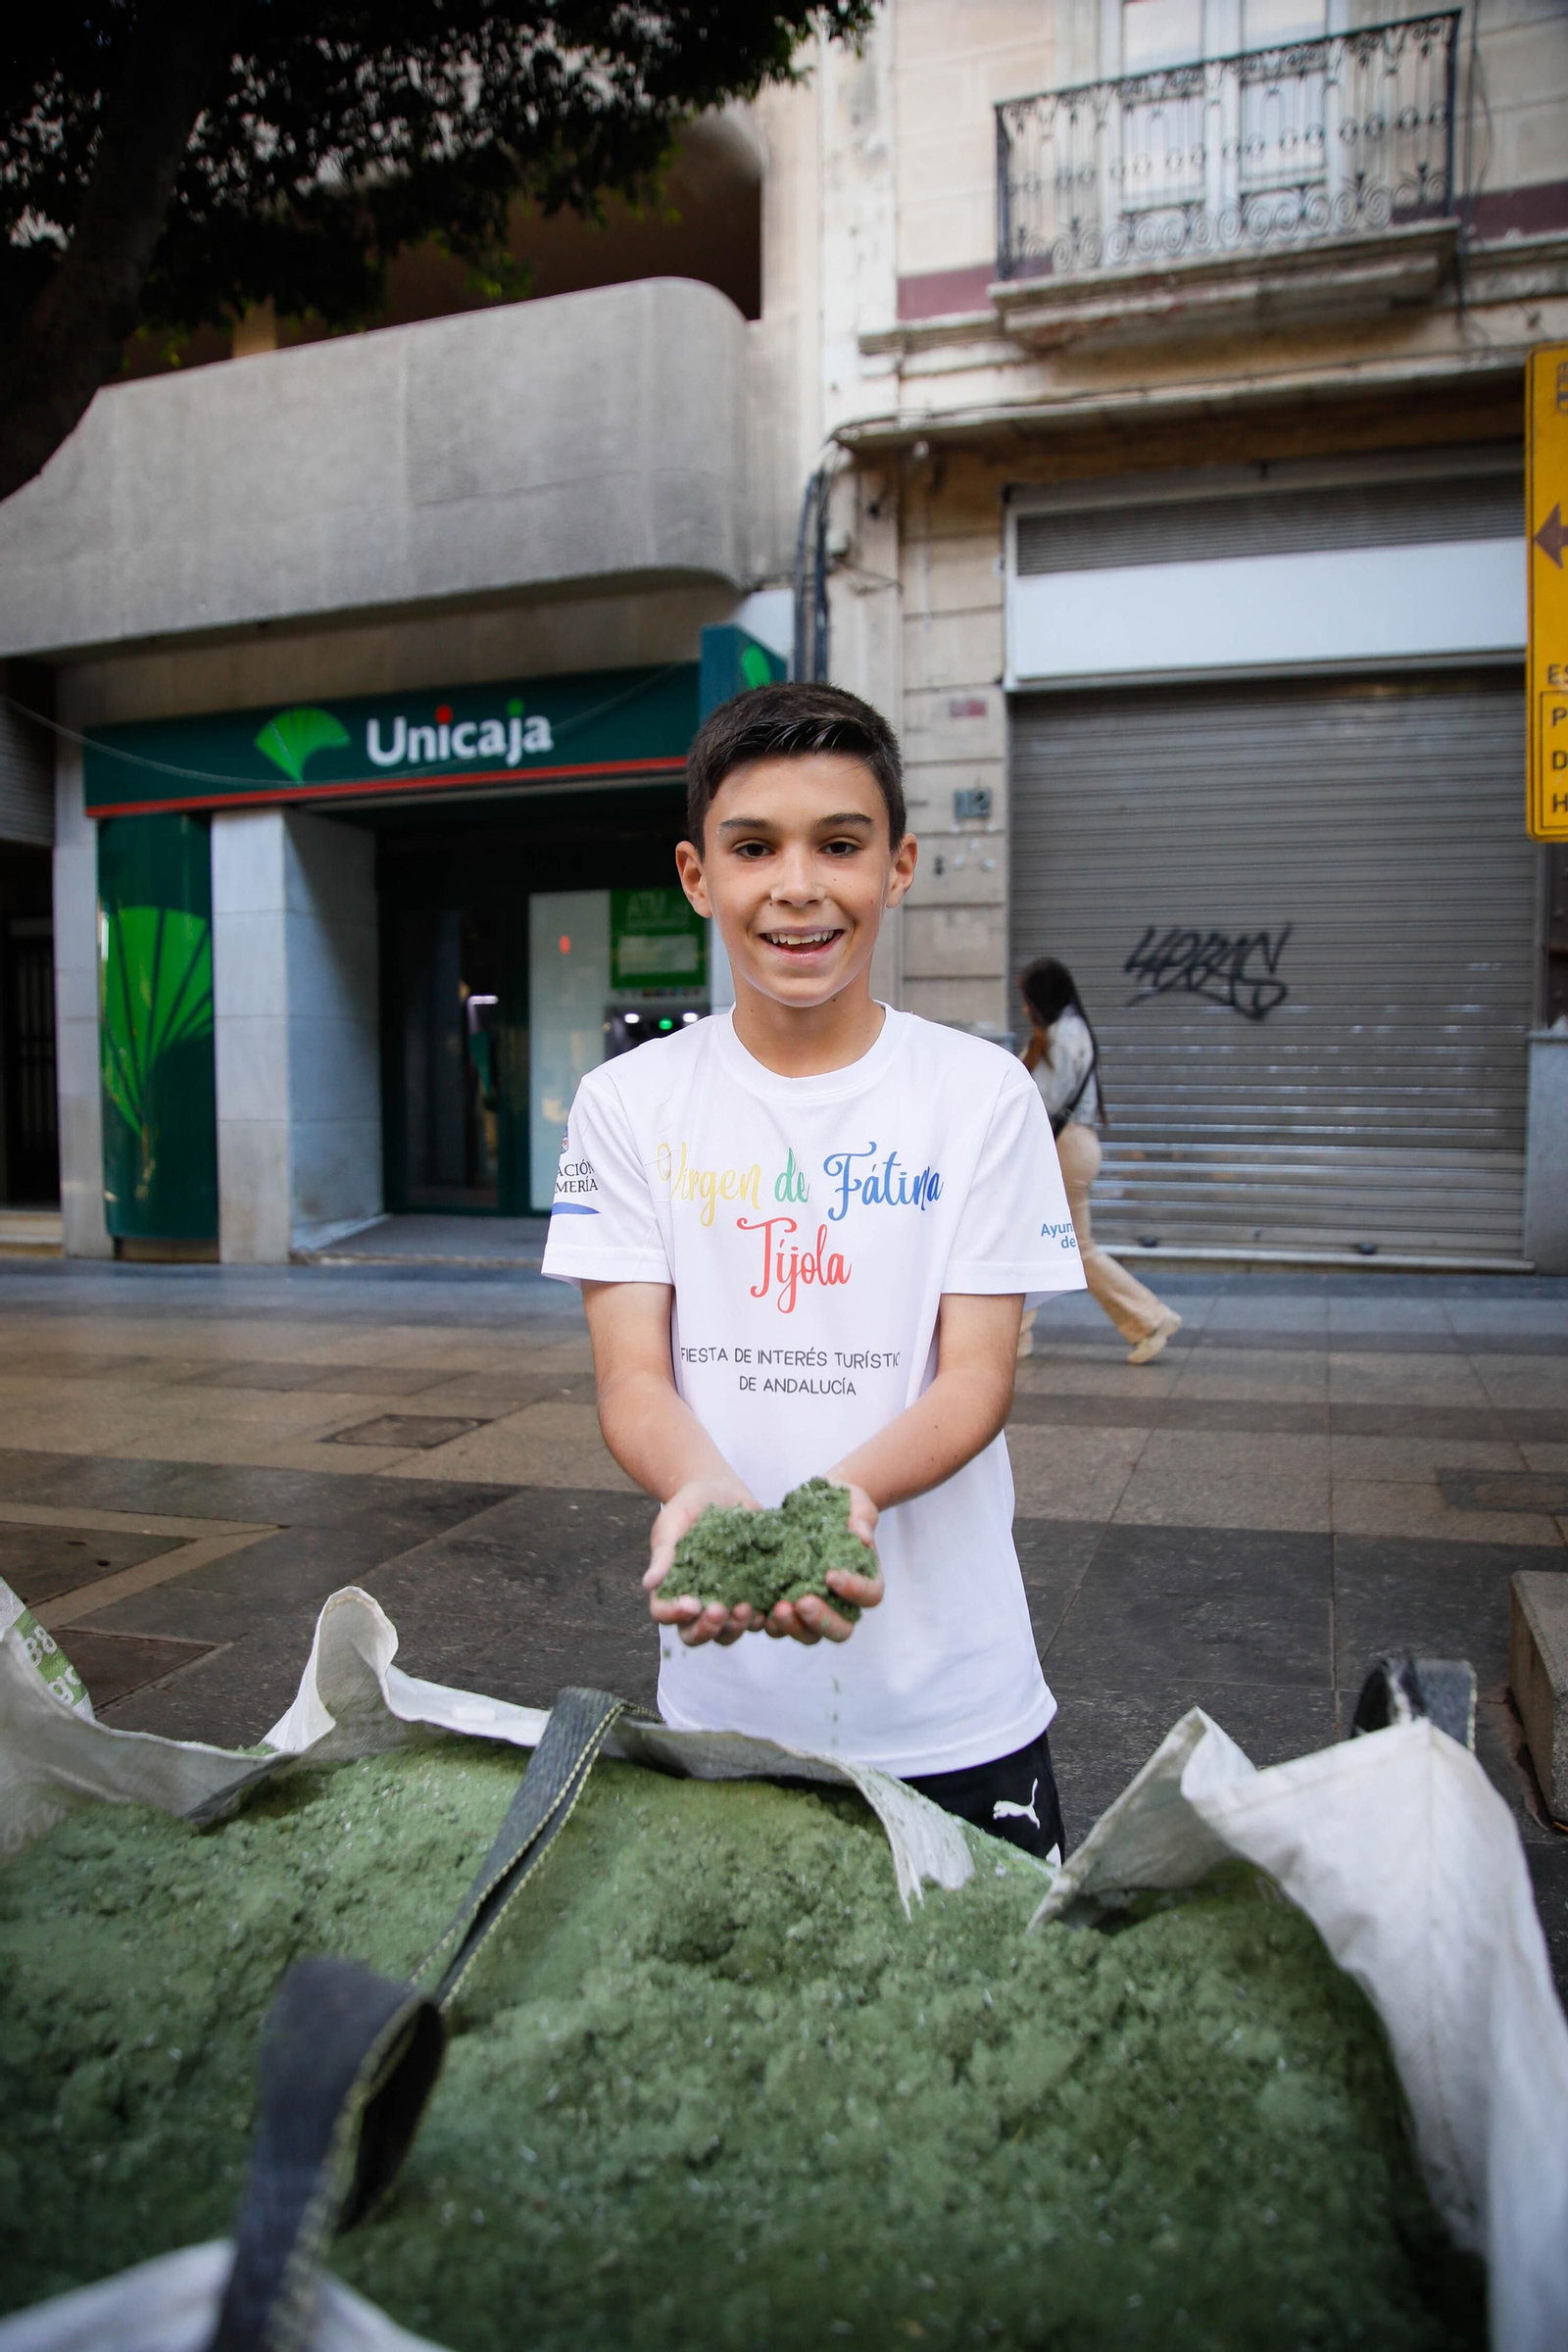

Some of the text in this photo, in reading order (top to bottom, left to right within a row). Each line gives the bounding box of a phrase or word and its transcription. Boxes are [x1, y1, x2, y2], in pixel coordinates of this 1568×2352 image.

[367, 698, 554, 767] Unicaja
[774, 1147, 810, 1203] de
[1060, 1235, 1077, 1250] de
[736, 1216, 852, 1314] Tíjola
[680, 1347, 729, 1363] FIESTA
[735, 1348, 752, 1363] DE
[758, 1347, 827, 1367] INTERÉS
[739, 1375, 857, 1396] DE ANDALUCÍA
